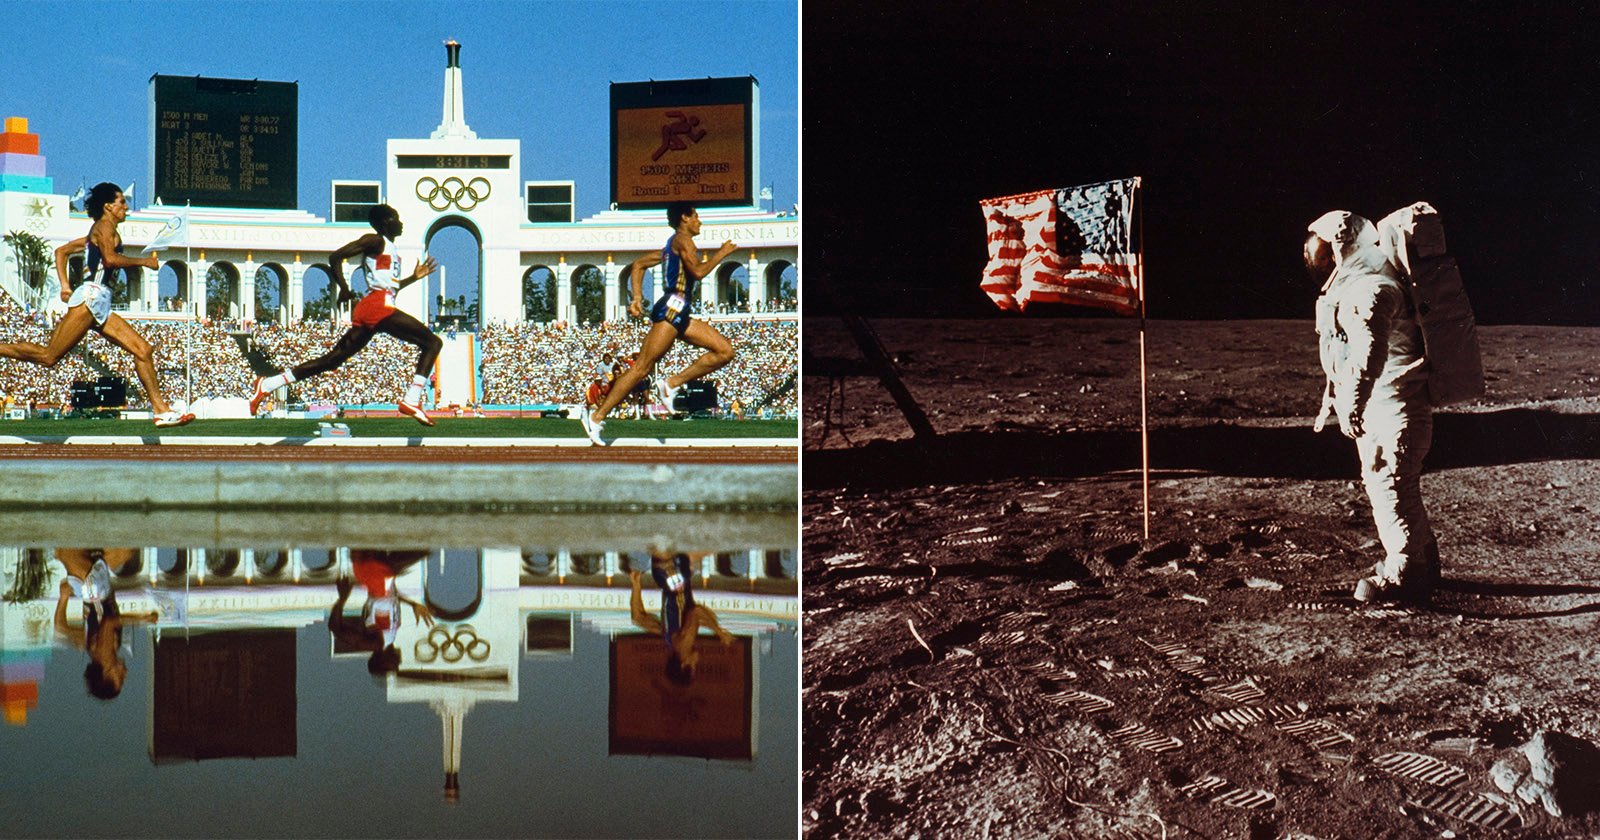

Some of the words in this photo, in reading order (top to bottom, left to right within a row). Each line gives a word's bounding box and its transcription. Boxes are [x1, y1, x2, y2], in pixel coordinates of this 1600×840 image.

[163, 111, 180, 120] 1500
[183, 112, 190, 120] M
[193, 112, 208, 120] MEN
[436, 156, 488, 168] 3:31.9
[640, 165, 670, 176] 1500
[675, 162, 730, 174] METERS
[670, 174, 700, 184] MEN
[632, 185, 670, 196] Round
[698, 183, 725, 194] Heat
[730, 182, 737, 192] 3
[578, 232, 656, 243] ANGELES
